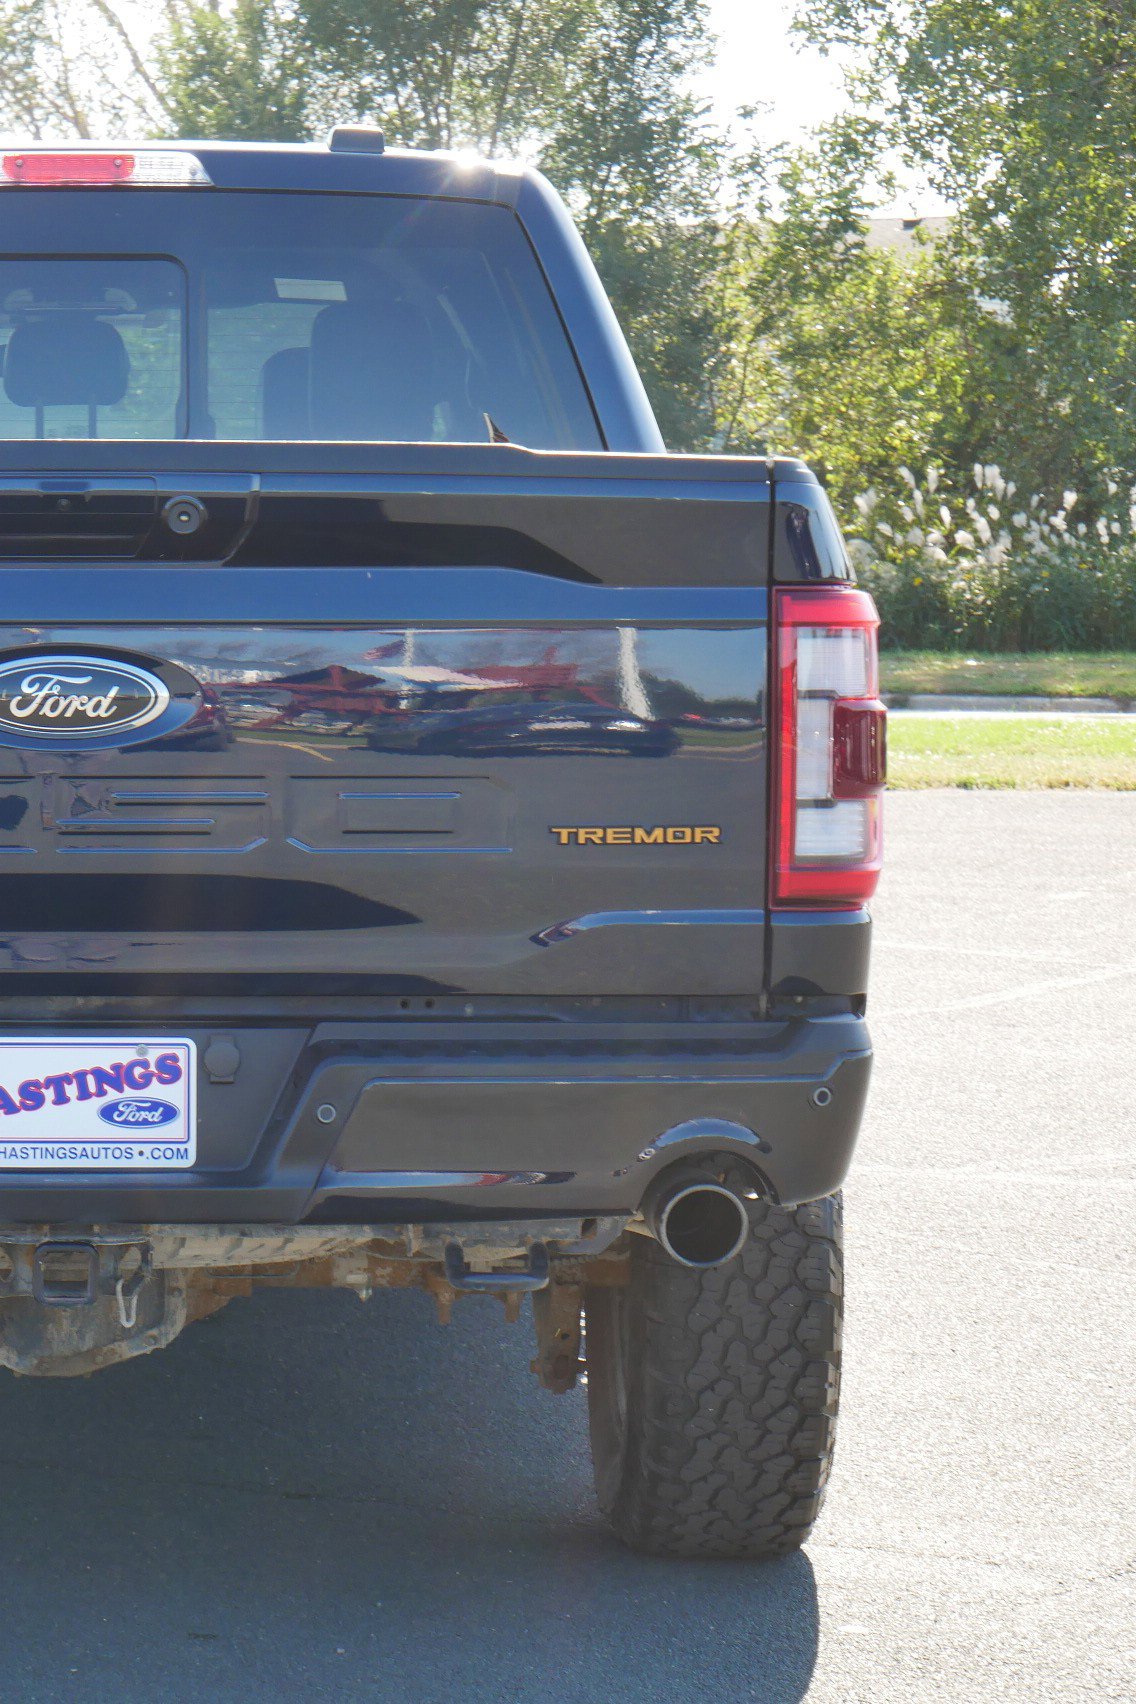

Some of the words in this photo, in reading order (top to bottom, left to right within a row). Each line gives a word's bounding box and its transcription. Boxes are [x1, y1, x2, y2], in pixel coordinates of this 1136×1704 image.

[9, 673, 120, 719] Ford
[549, 826, 722, 845] TREMOR
[112, 1101, 163, 1124] Ford
